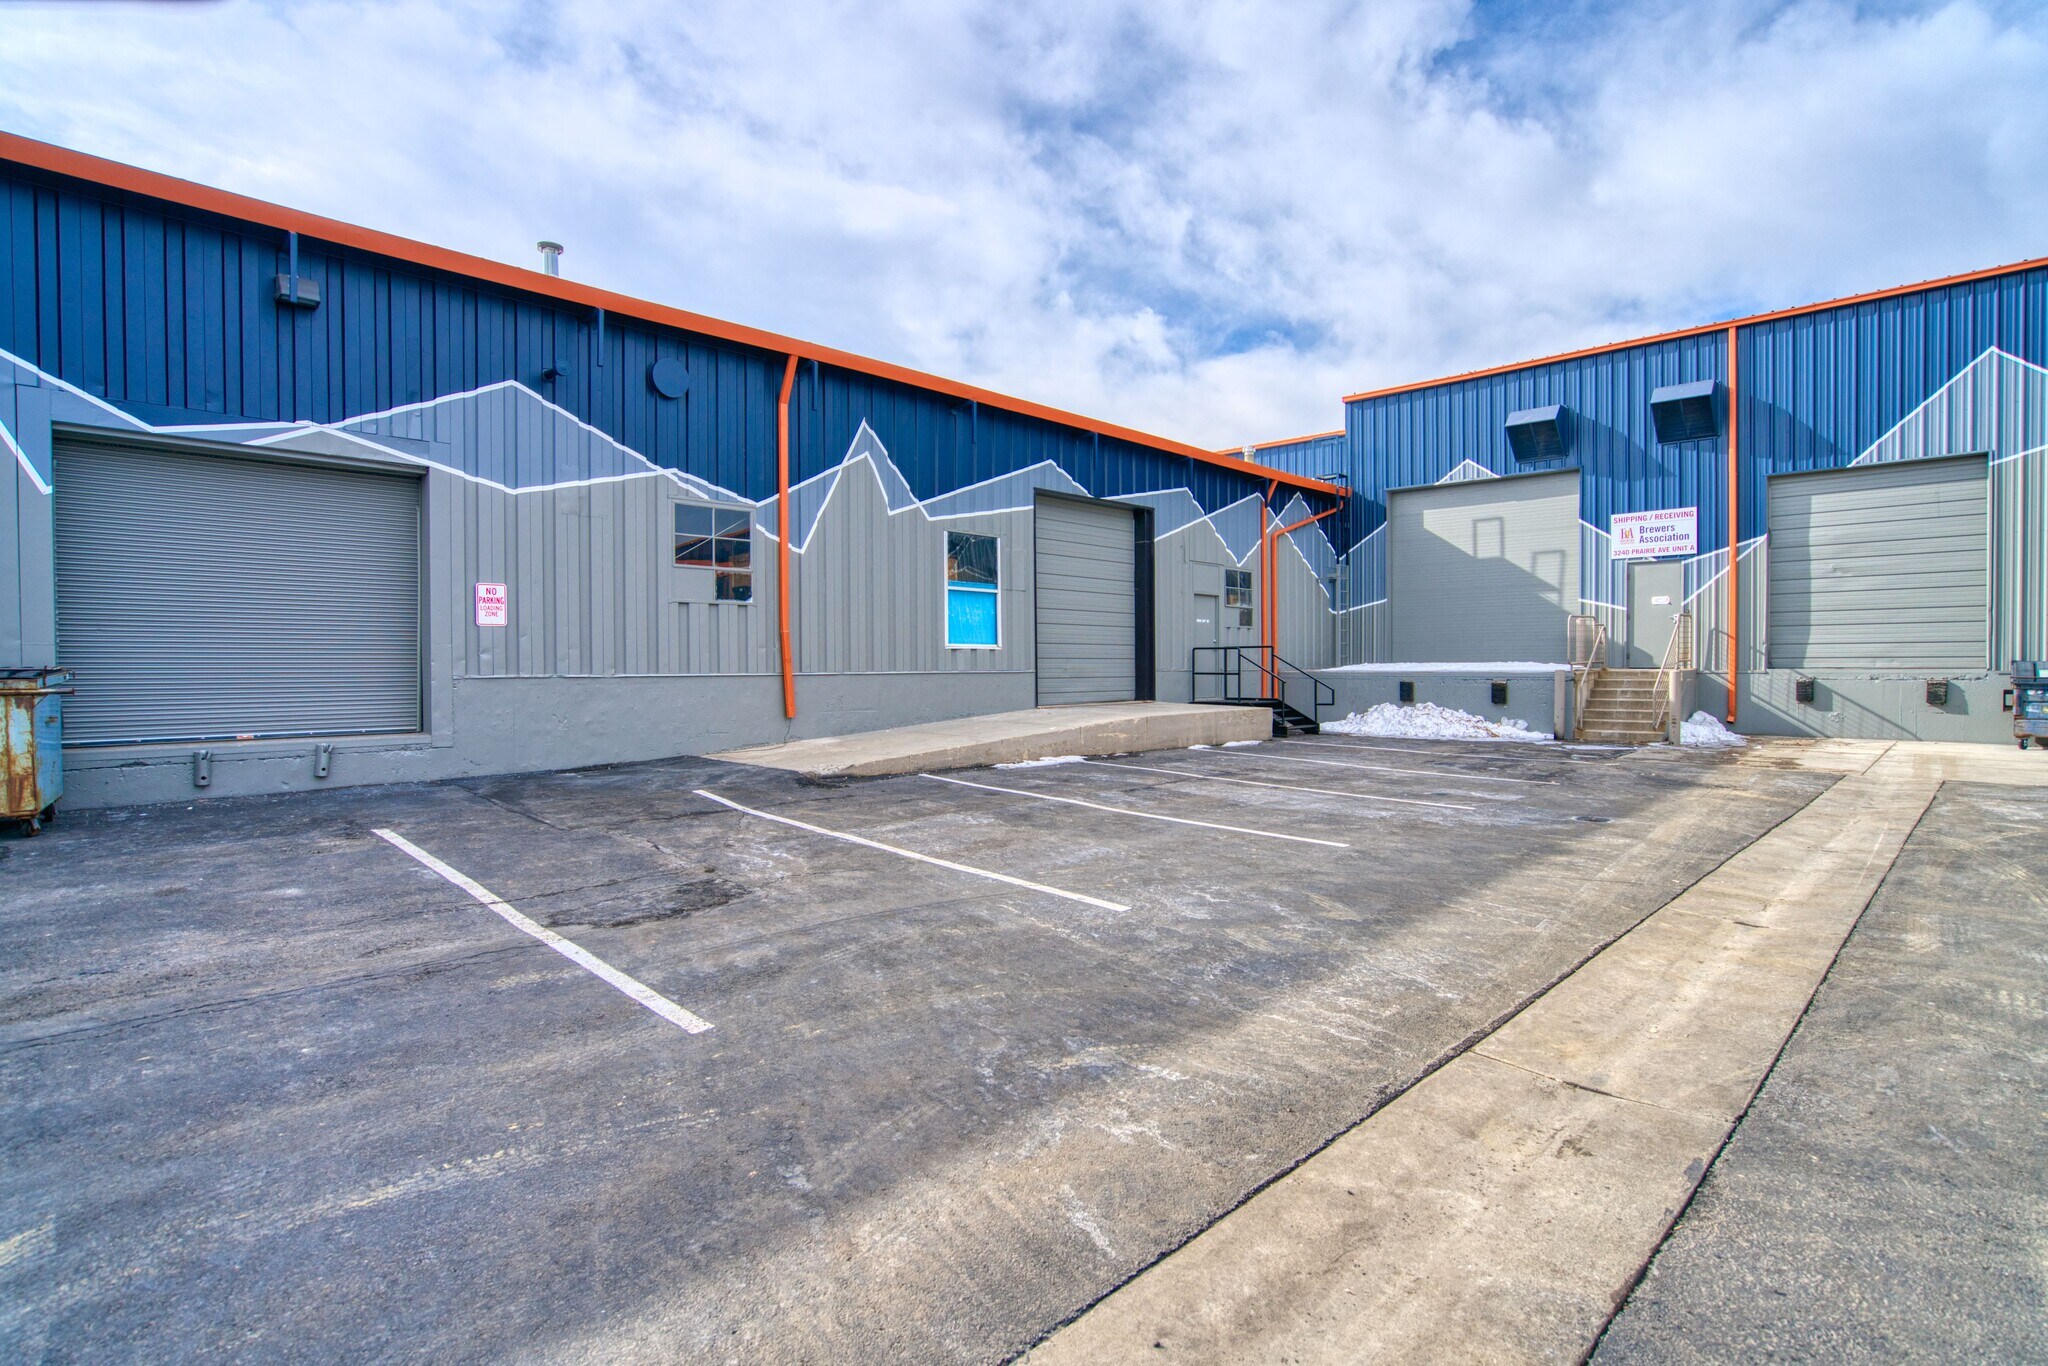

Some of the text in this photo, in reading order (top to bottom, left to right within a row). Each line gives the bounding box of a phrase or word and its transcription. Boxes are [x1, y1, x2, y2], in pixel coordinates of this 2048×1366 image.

[1613, 515, 1647, 524] SHIPPING
[1654, 510, 1694, 520] RECEIVING
[1639, 525, 1675, 534] Brewers
[1639, 533, 1690, 544] Association
[486, 588, 496, 596] NO
[479, 596, 504, 604] PARKING
